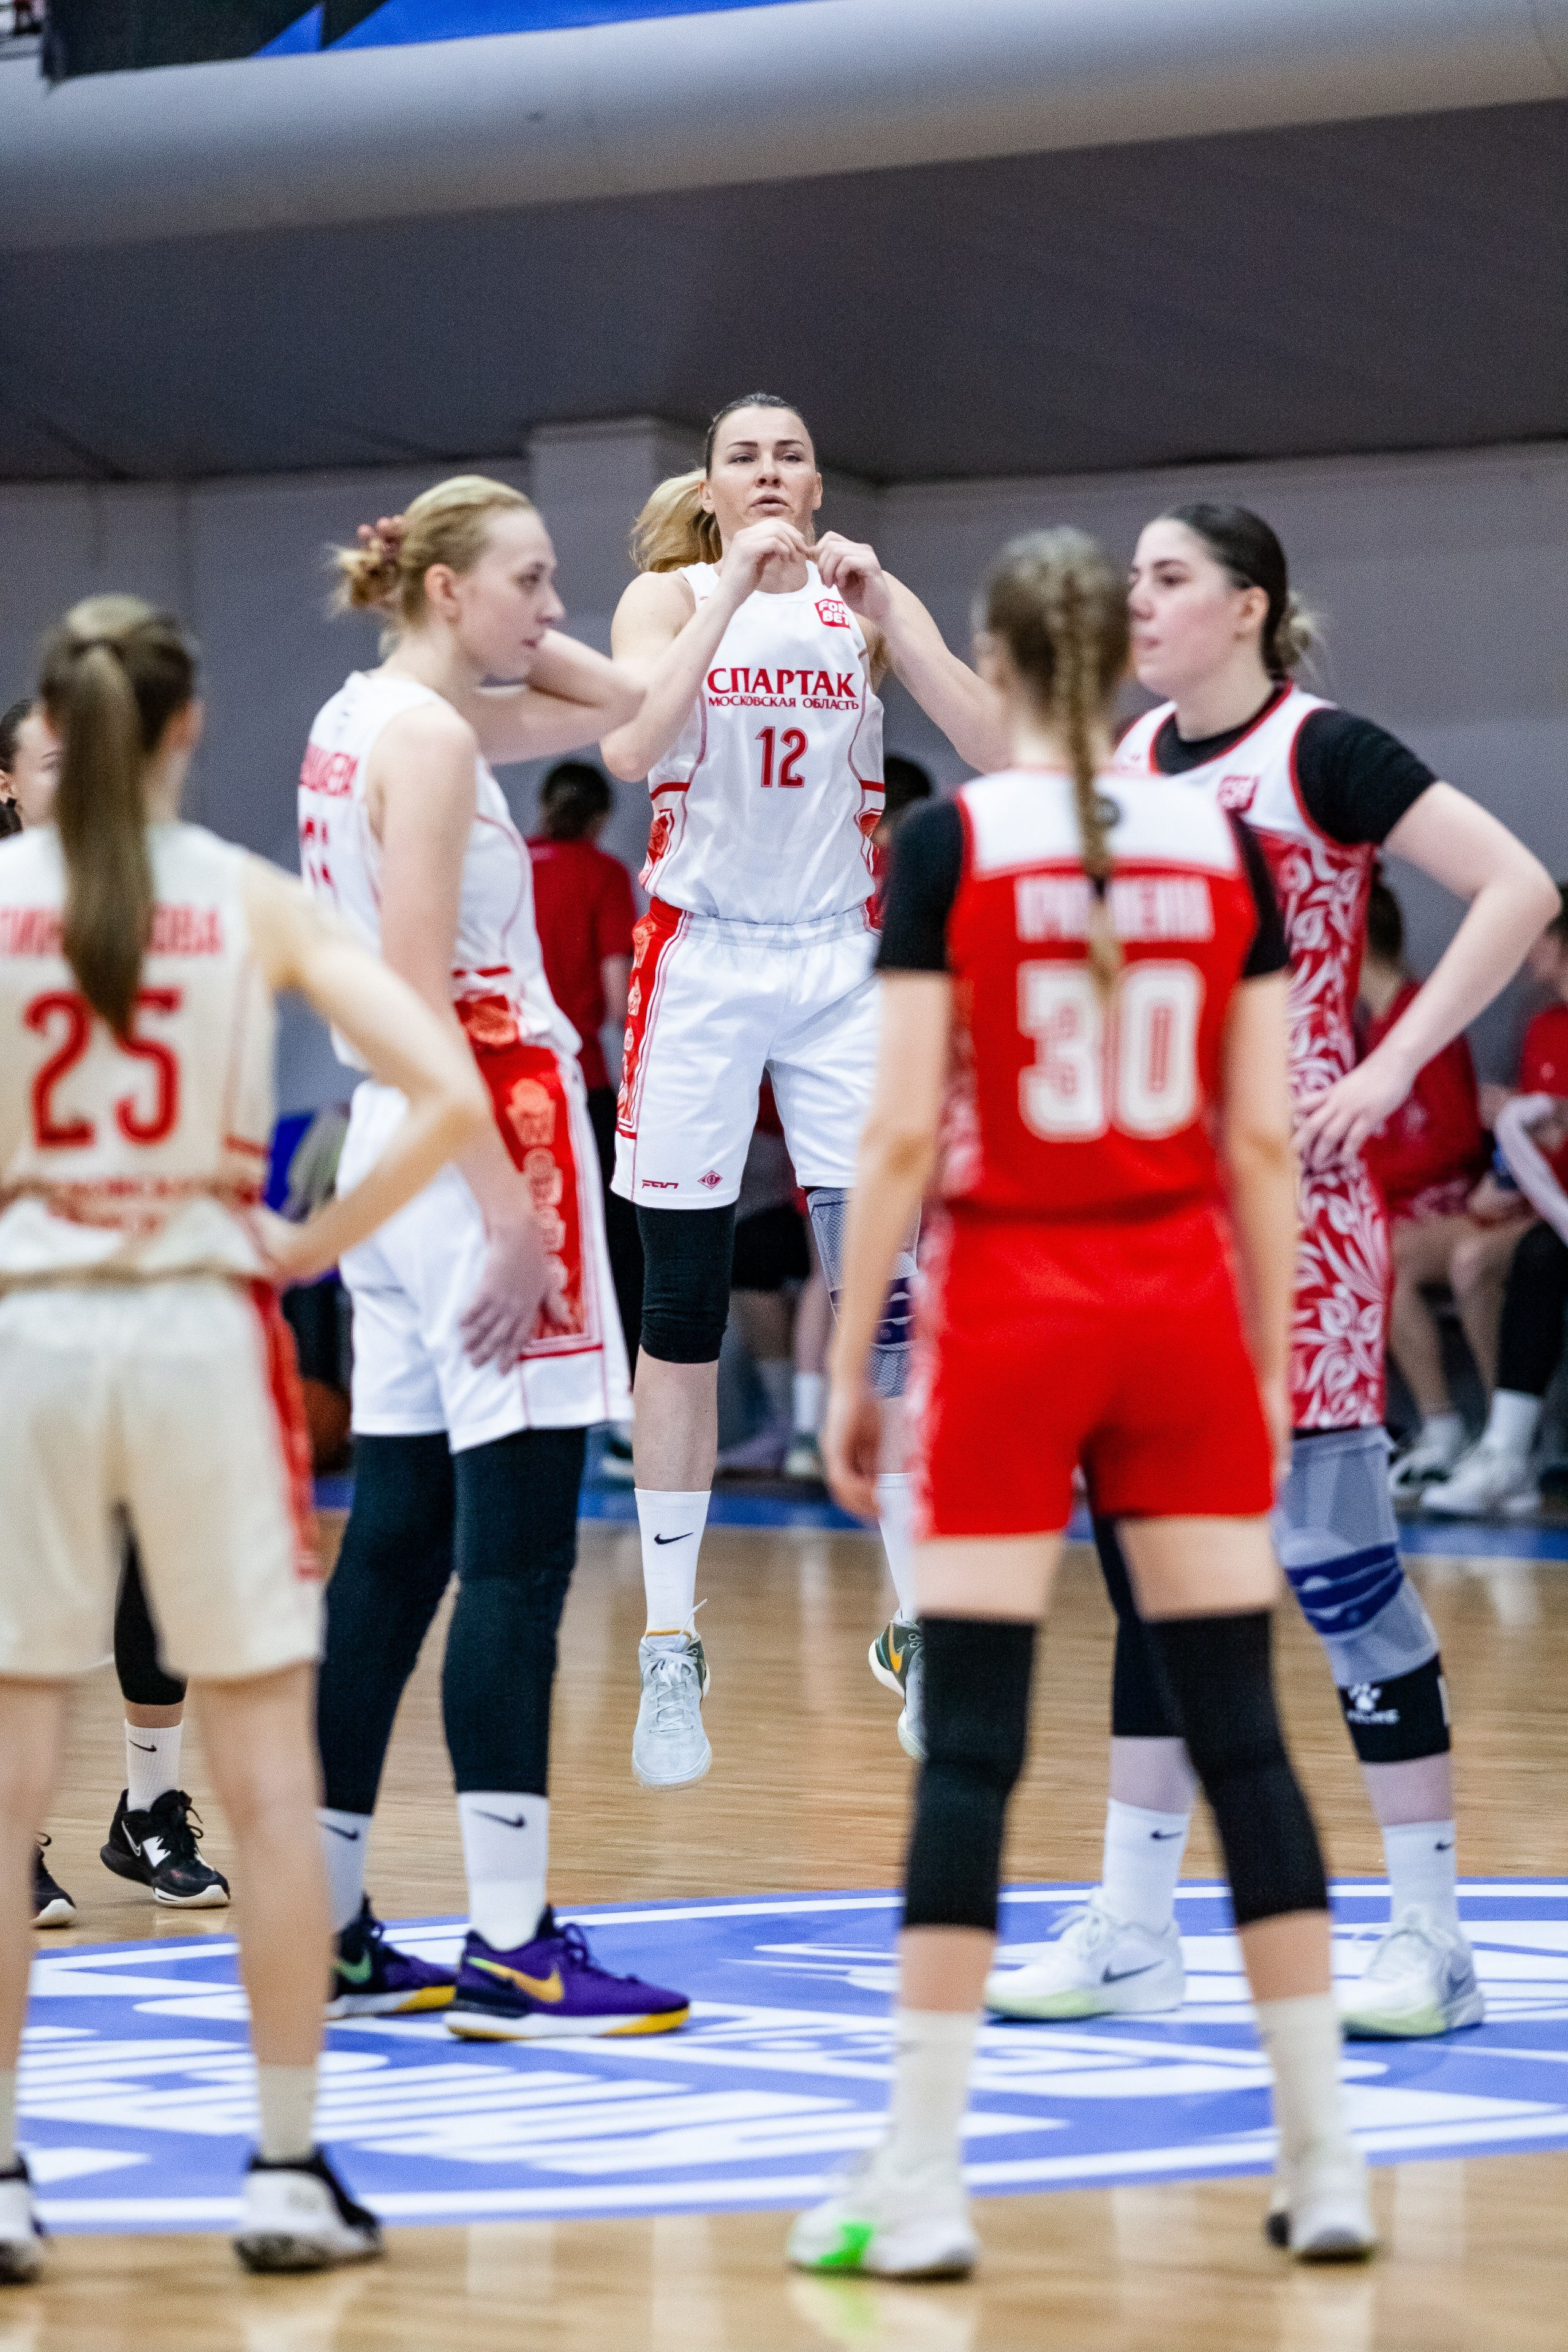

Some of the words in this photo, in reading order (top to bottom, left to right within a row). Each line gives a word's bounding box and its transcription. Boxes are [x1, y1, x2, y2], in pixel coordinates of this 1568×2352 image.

[818, 600, 846, 614] FON
[823, 610, 850, 625] BET
[707, 667, 856, 698] СПАРТАК
[708, 695, 796, 707] МОСКОВСКАЯ
[802, 698, 859, 710] ОБЛАСТЬ
[755, 726, 809, 788] 12
[1017, 958, 1207, 1143] 30
[23, 986, 183, 1147] 25
